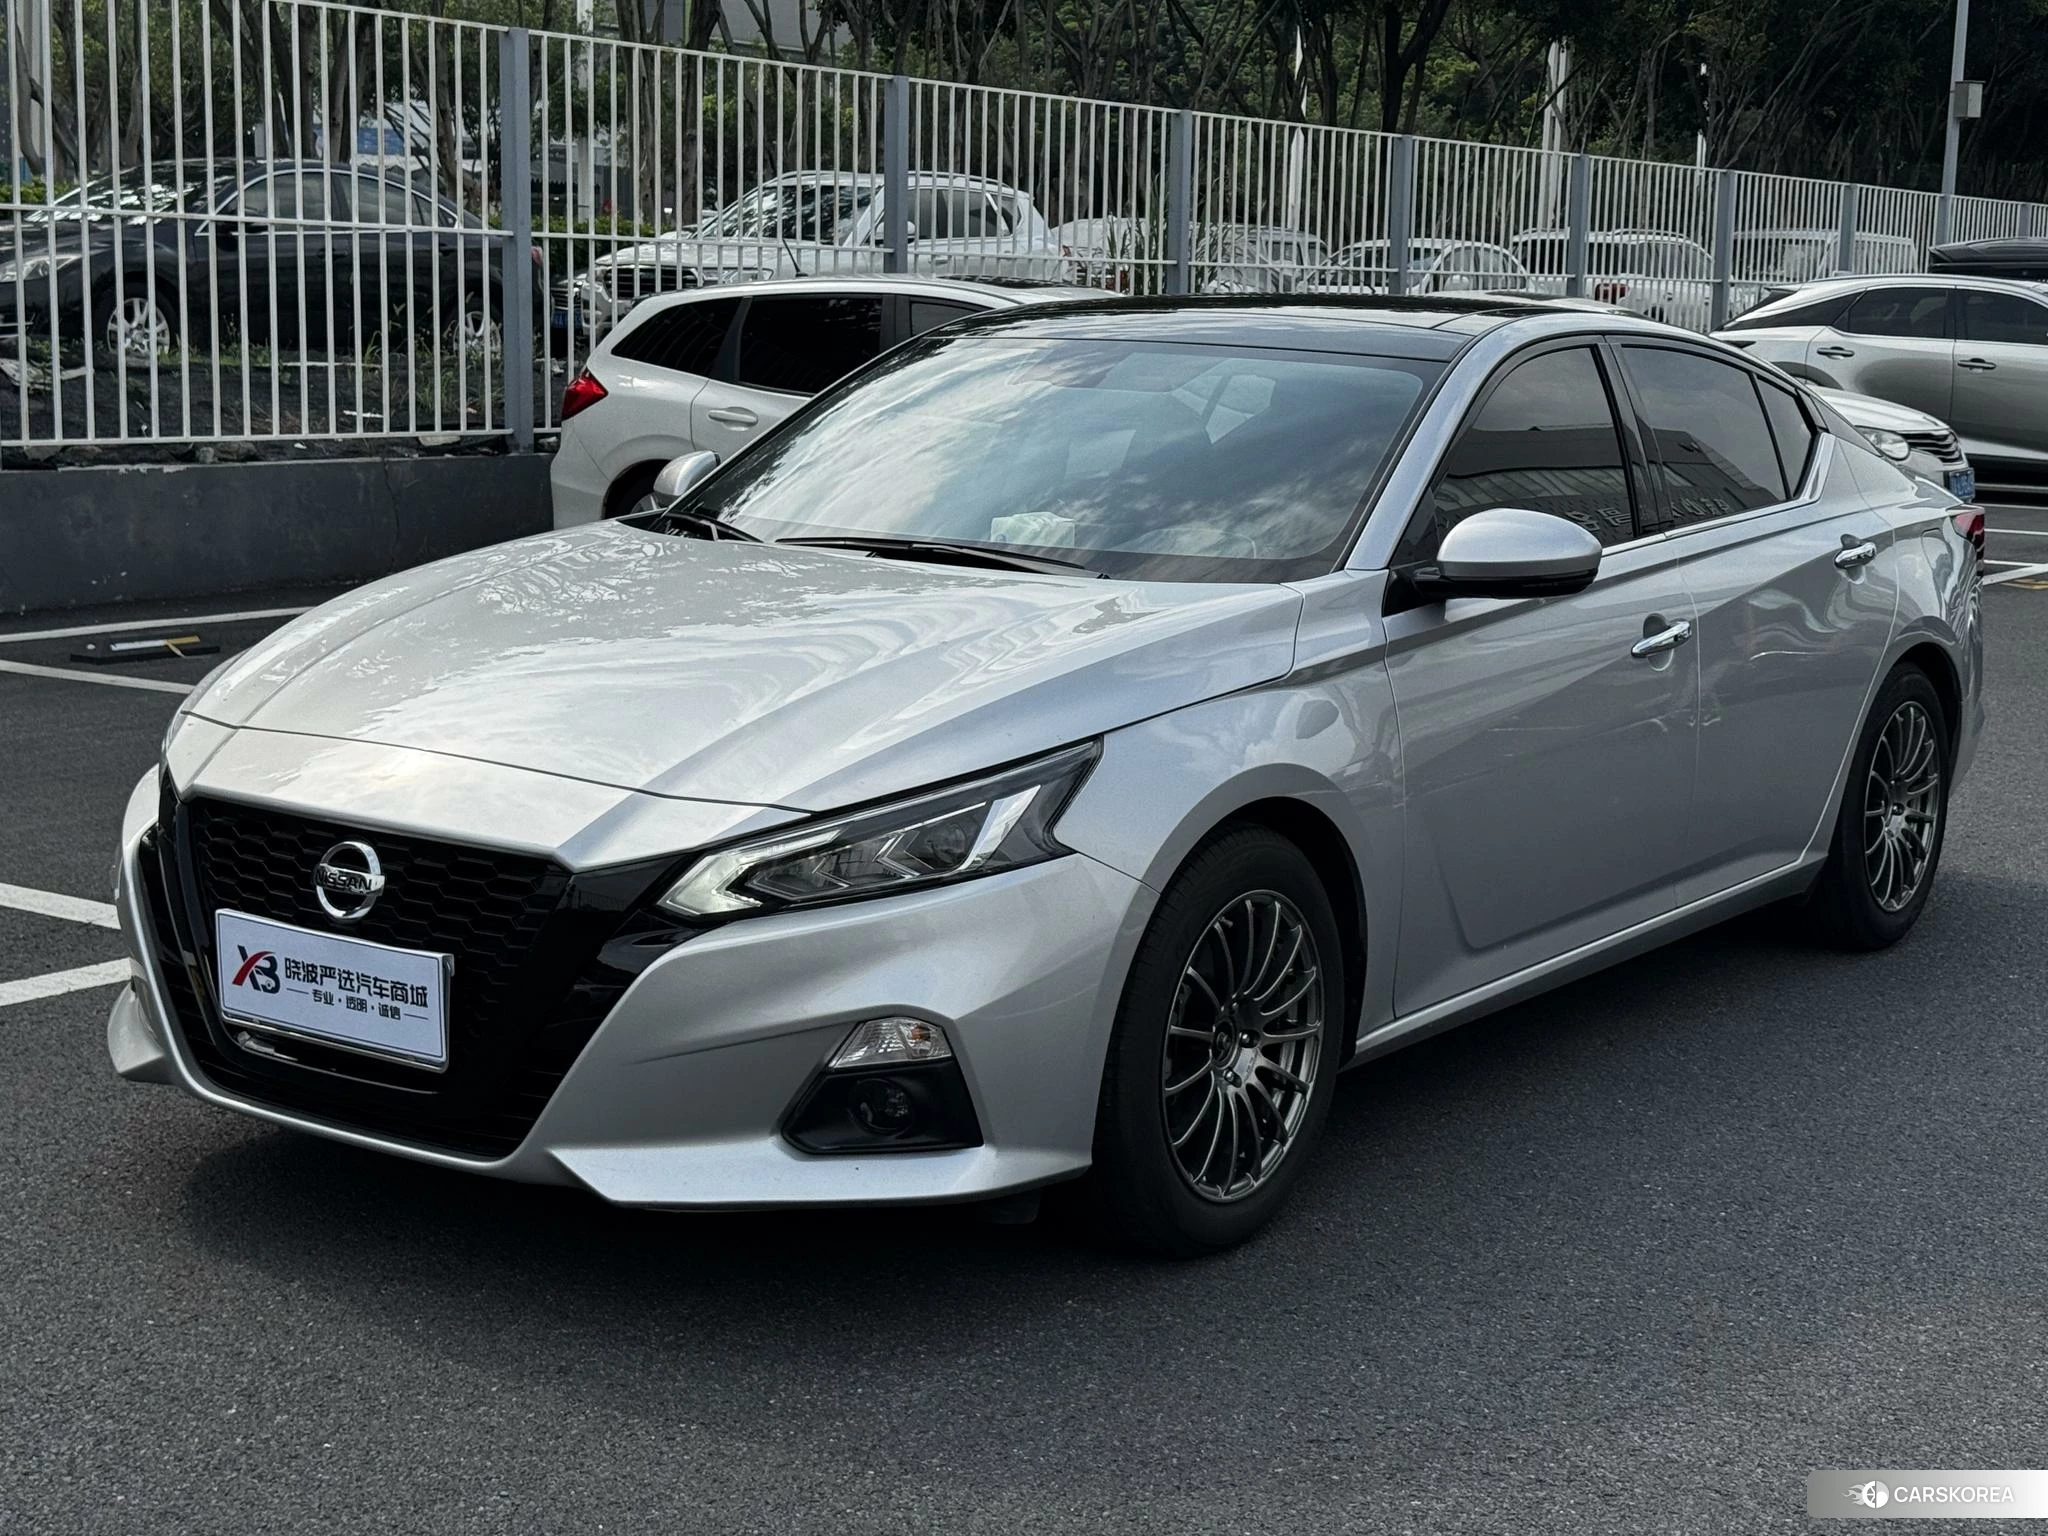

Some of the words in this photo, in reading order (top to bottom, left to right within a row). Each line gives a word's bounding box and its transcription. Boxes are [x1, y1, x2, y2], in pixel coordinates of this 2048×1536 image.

[316, 867, 373, 891] NISSAN
[284, 957, 428, 1008] 晓波严选汽车商城
